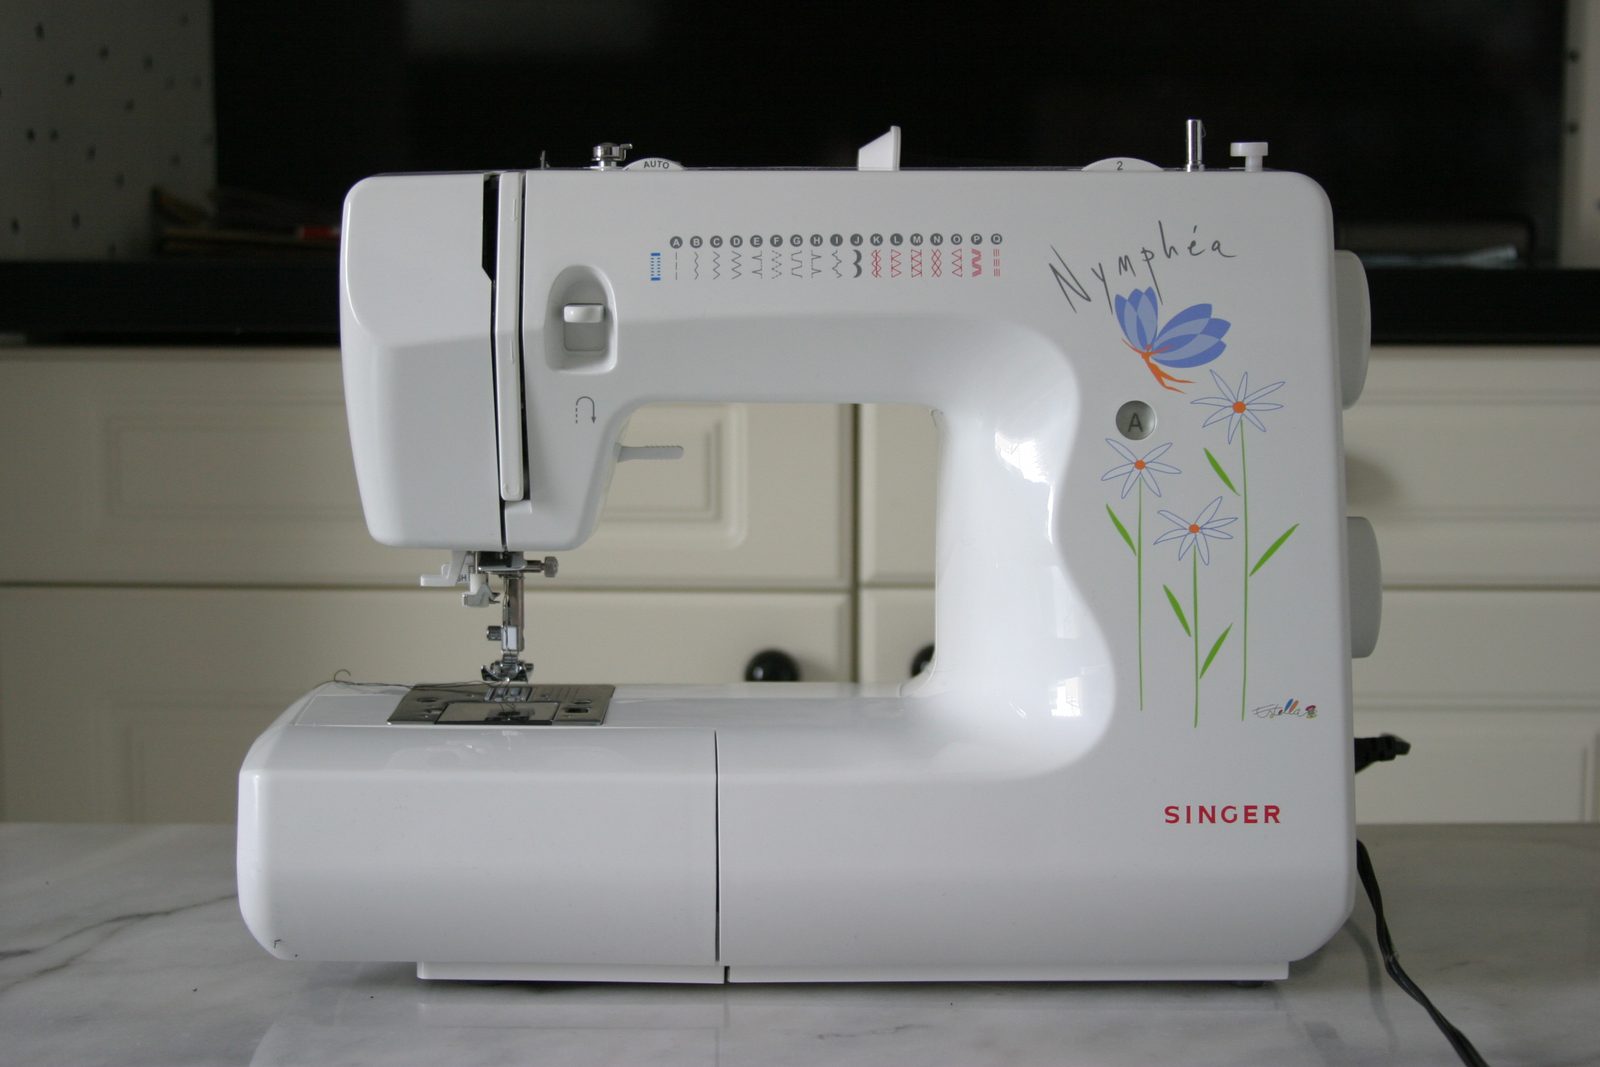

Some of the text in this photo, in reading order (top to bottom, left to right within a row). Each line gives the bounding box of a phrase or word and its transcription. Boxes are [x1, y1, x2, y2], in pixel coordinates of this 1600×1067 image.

[643, 160, 670, 169] AUTO
[1116, 161, 1123, 171] 2
[1049, 220, 1237, 315] Nymphéa
[1127, 412, 1144, 432] A
[1164, 805, 1280, 824] SINGER
